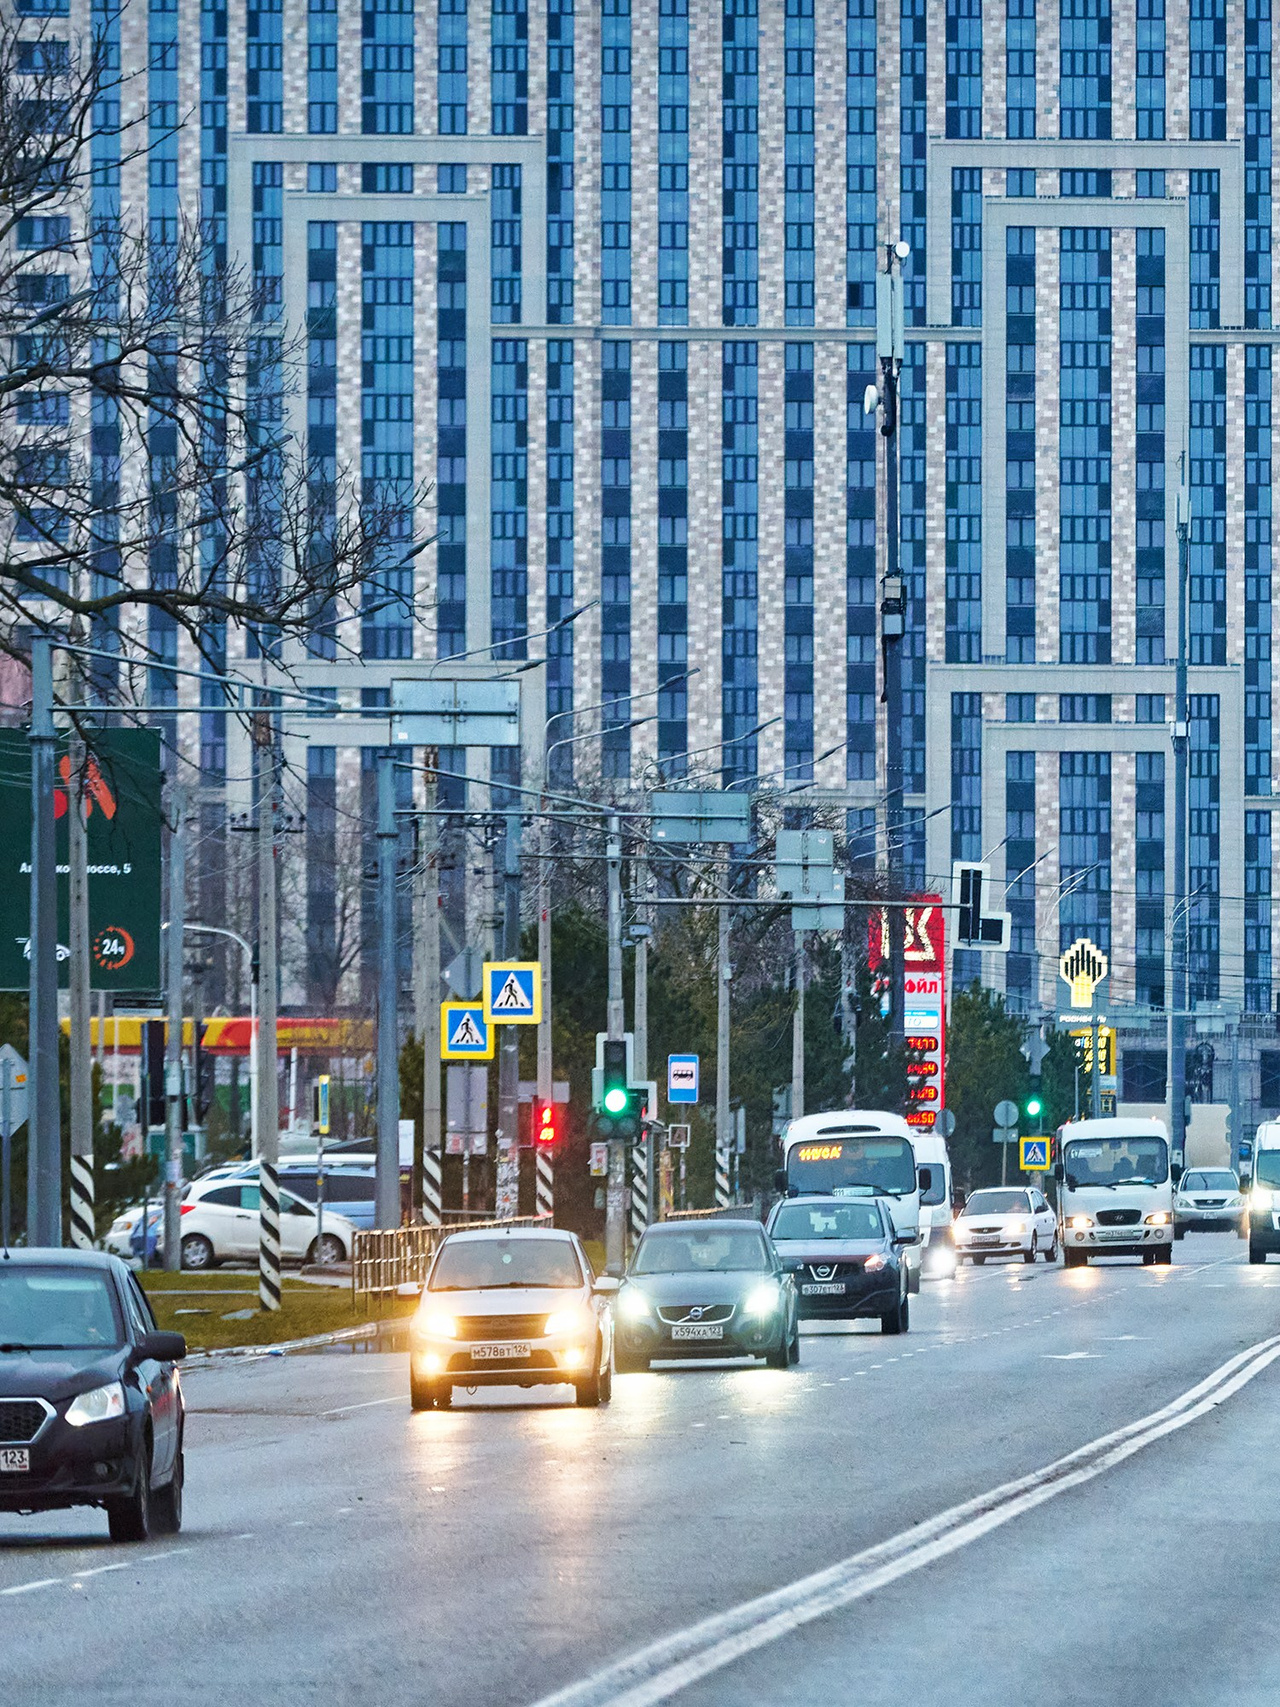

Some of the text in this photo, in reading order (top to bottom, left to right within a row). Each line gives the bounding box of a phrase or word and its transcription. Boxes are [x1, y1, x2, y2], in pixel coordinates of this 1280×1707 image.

[123, 863, 132, 874] 5
[473, 1344, 528, 1358] М578ВТ 126
[2, 1450, 24, 1465] 123
